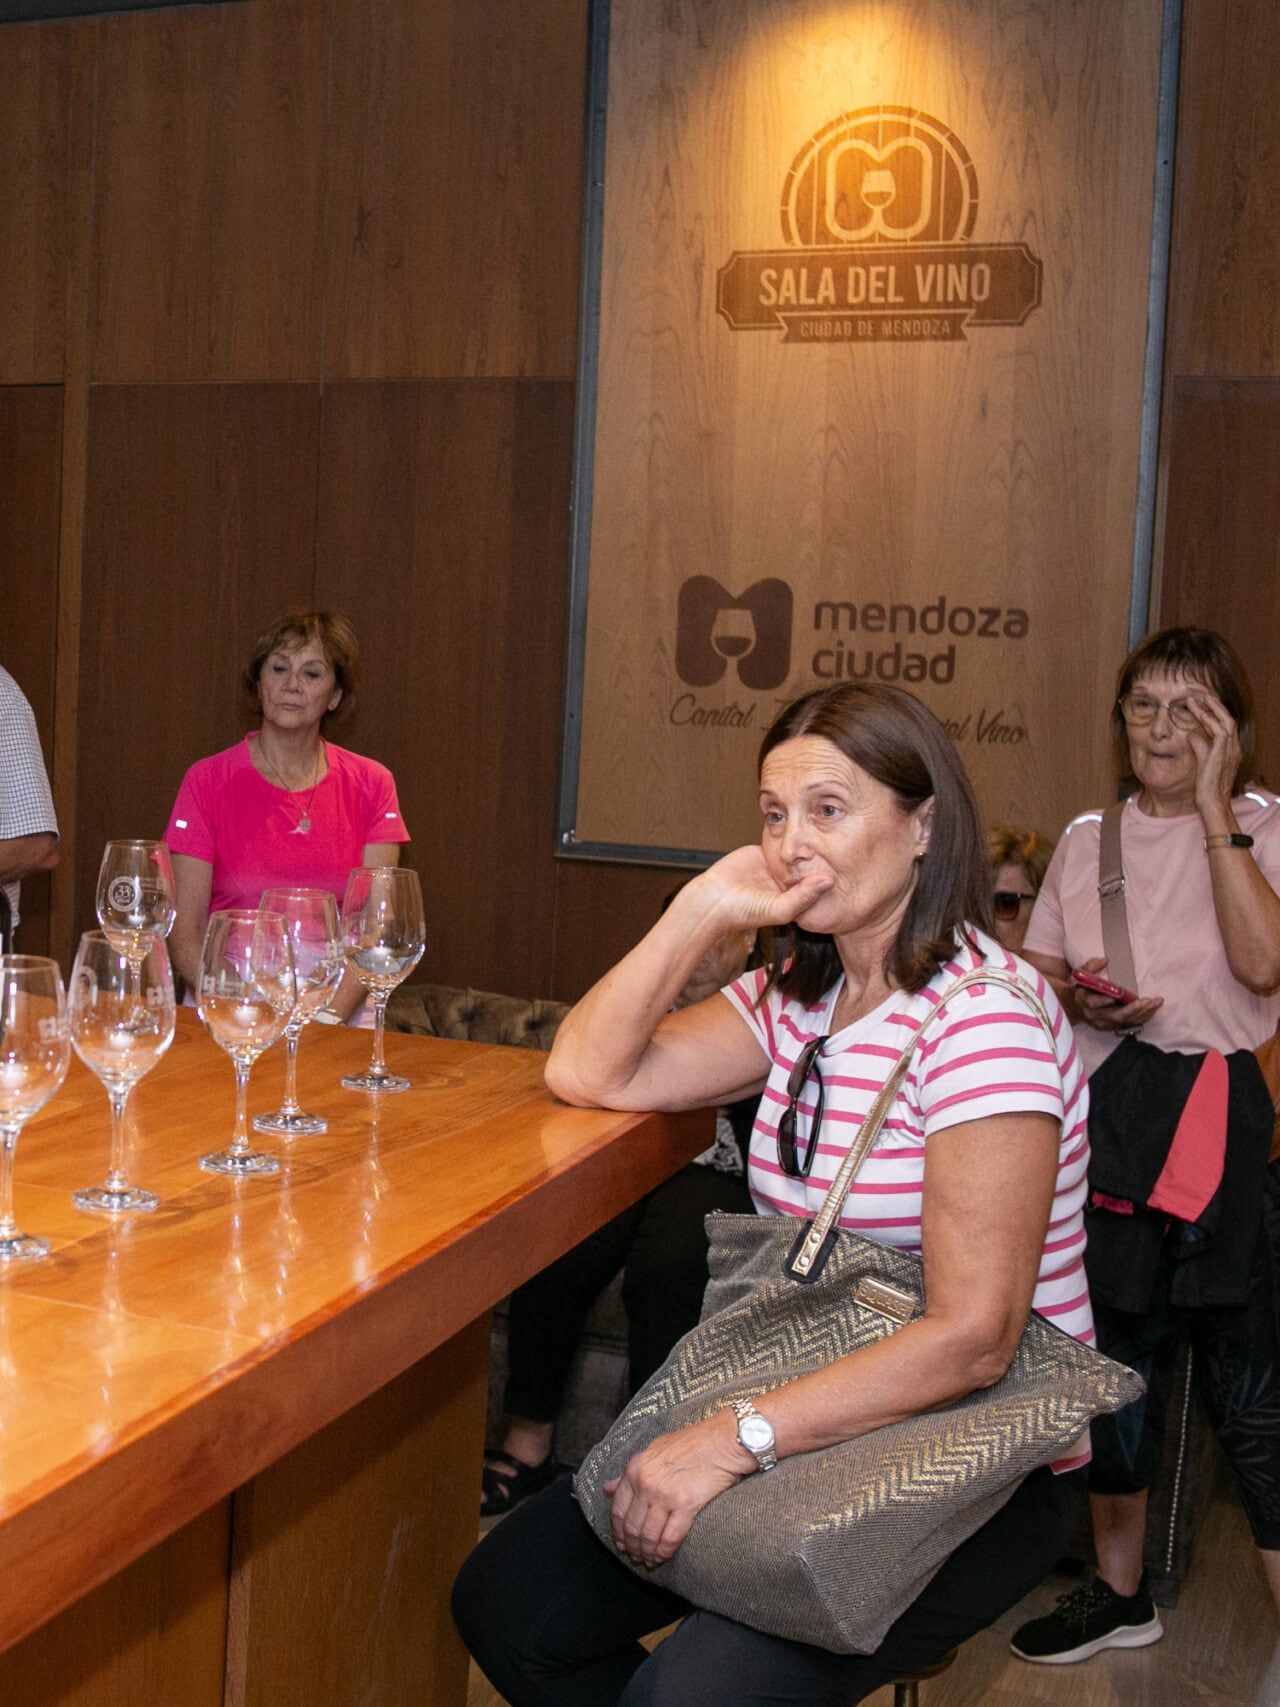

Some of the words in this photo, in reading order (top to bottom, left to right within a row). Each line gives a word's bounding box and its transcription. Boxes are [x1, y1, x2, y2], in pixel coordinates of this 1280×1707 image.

[759, 267, 837, 306] SALA
[847, 265, 904, 304] DEL
[915, 262, 992, 303] VINO
[800, 320, 852, 337] CIUDAD
[857, 320, 874, 336] DE
[882, 319, 951, 336] MENDOZA
[813, 596, 1030, 640] mendoza
[812, 641, 957, 684] ciudad
[976, 708, 1029, 745] Vino
